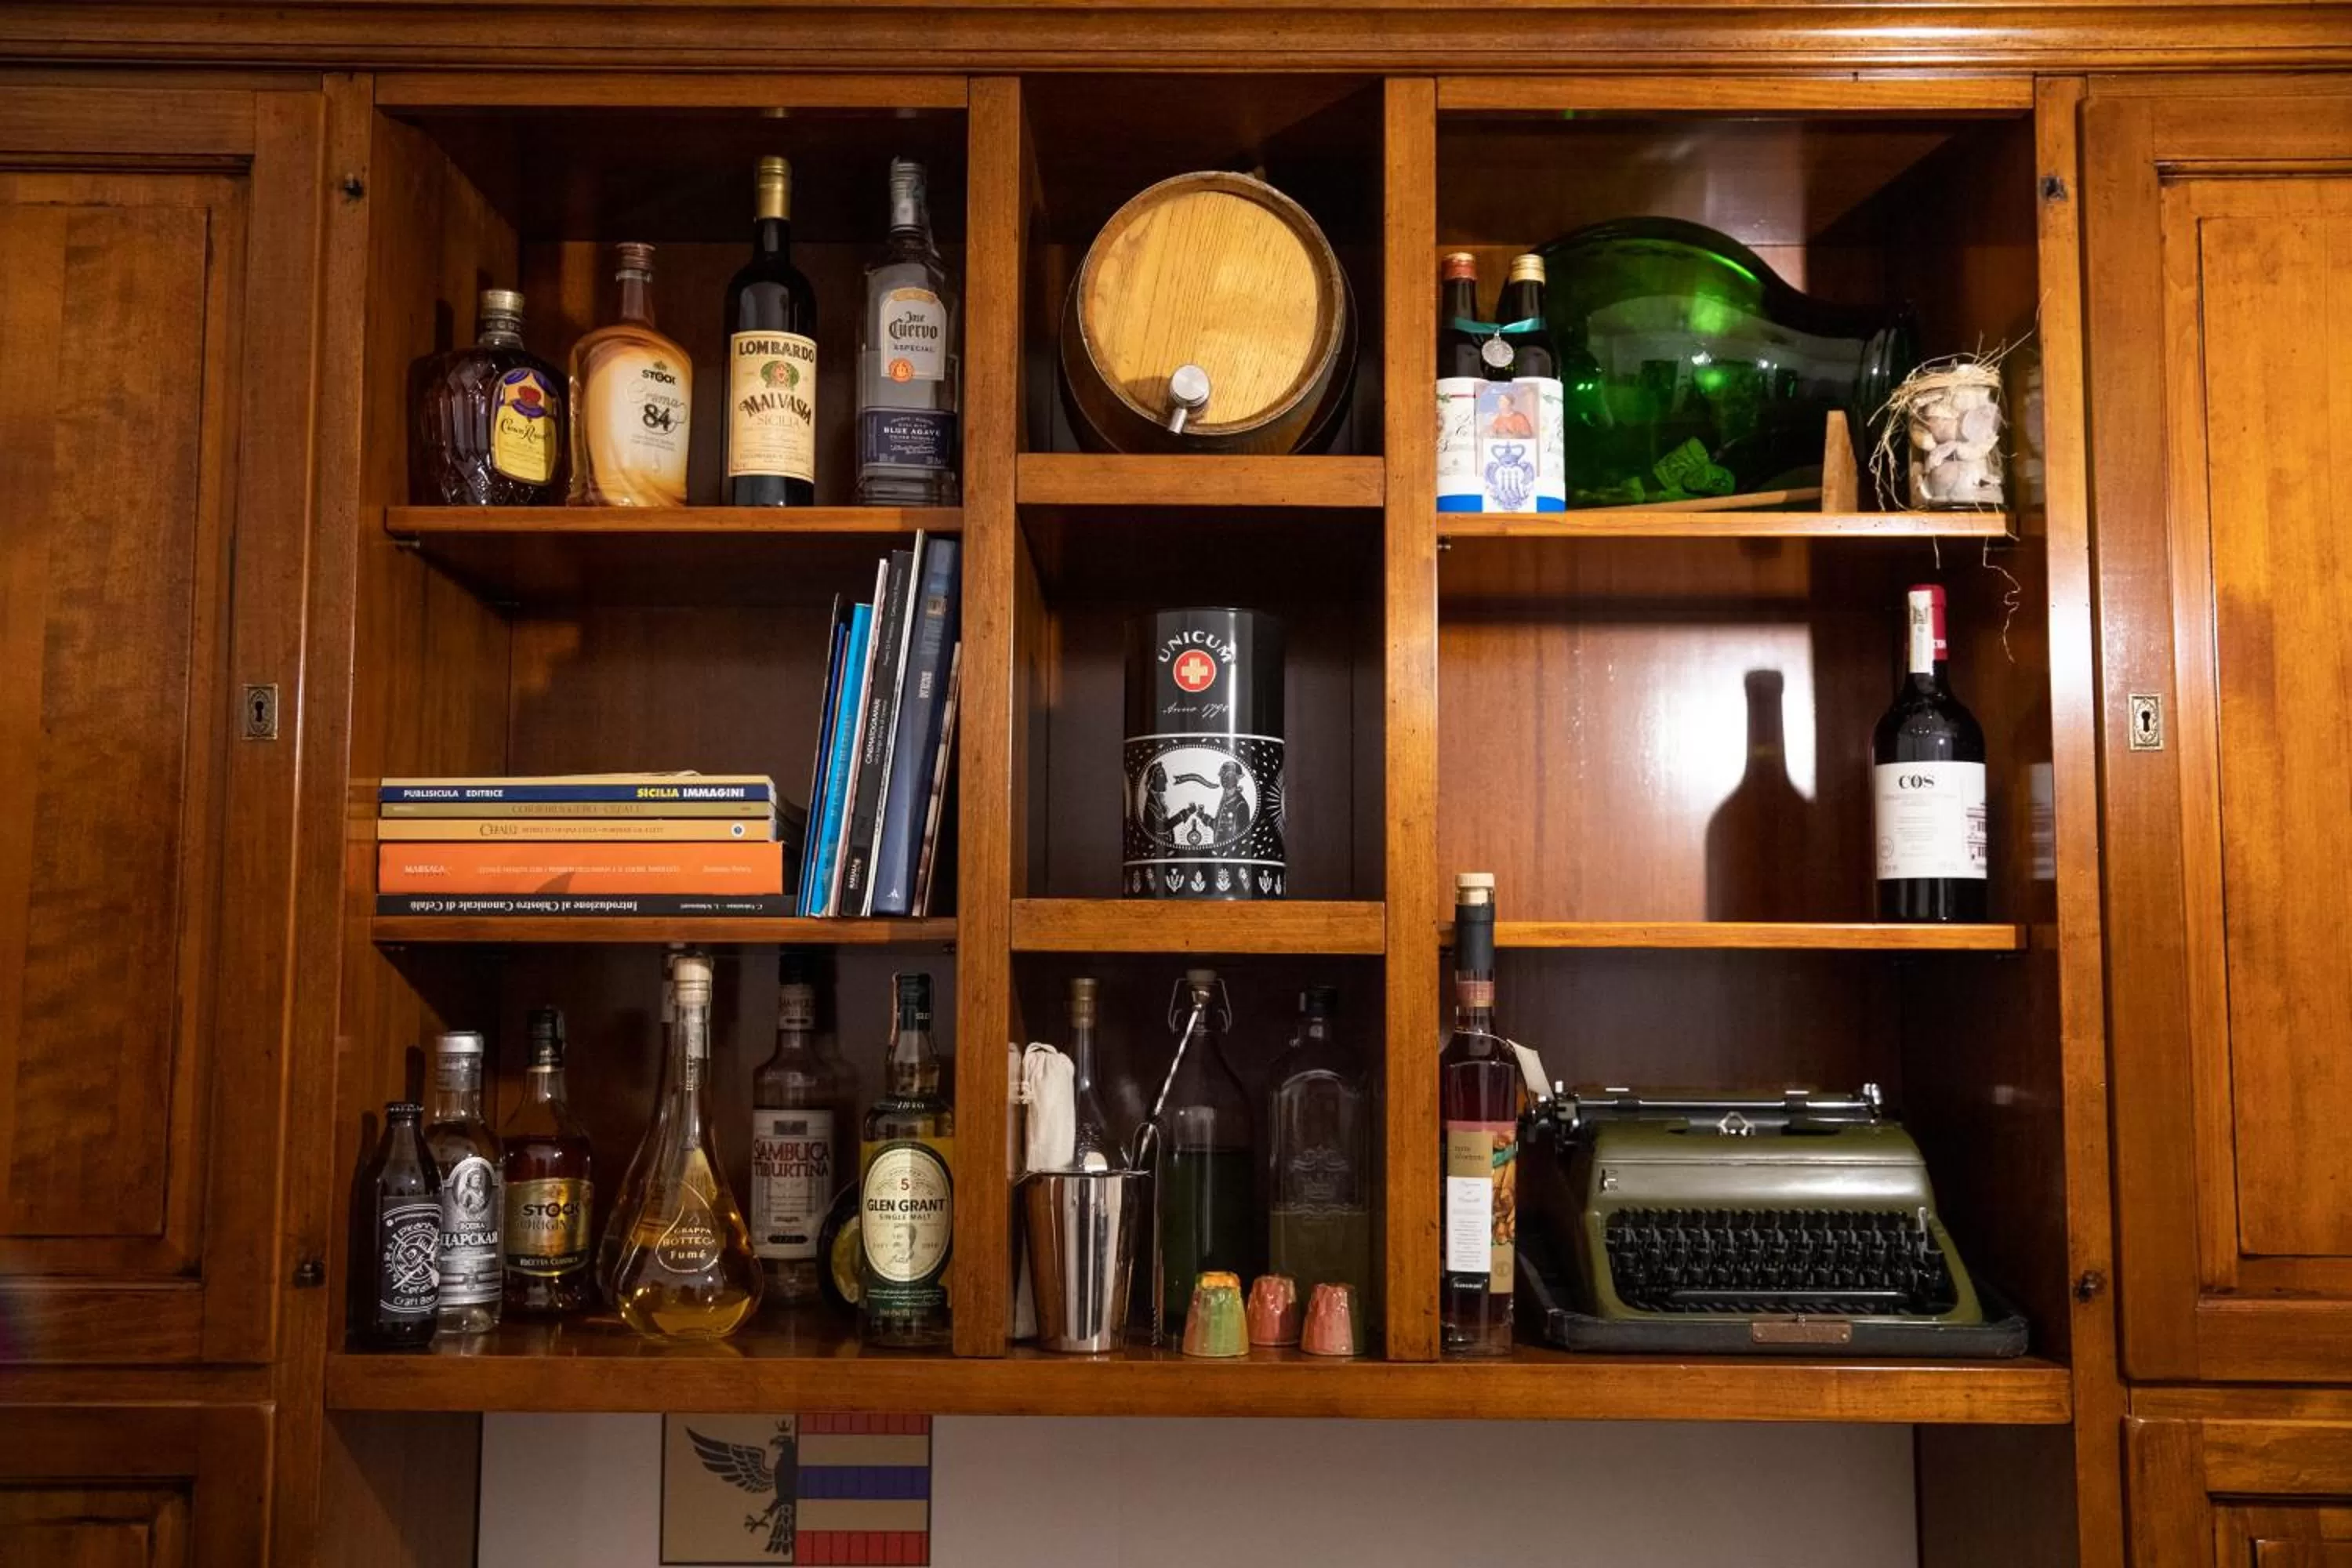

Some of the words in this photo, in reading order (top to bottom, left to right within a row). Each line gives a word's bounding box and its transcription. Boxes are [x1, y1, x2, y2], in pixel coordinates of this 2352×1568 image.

[889, 318, 938, 339] Cuervo
[739, 339, 815, 363] LOMBARDO
[894, 344, 935, 353] ESPECIAL
[641, 369, 677, 385] STOCK
[739, 393, 811, 426] MALVASIA
[642, 404, 672, 432] 84
[910, 428, 942, 437] AGAVE
[1158, 630, 1233, 664] UNICUM
[1899, 774, 1936, 789] COS
[636, 788, 680, 798] SICILIA
[683, 788, 746, 798] IMMAGINI
[410, 901, 444, 913] Cefalù
[445, 901, 457, 912] di
[458, 901, 514, 912] Canonicale
[515, 901, 559, 913] Chiostro
[561, 901, 572, 912] al
[574, 901, 638, 912] Introduzione
[753, 1139, 829, 1161] SAMBUCA
[753, 1161, 829, 1178] TIBURTINA
[901, 1178, 910, 1191] 5
[522, 1202, 580, 1218] STOCK
[867, 1198, 895, 1212] GLEN
[898, 1198, 946, 1213] GRANT
[439, 1230, 499, 1249] ЦАРСКАЯ
